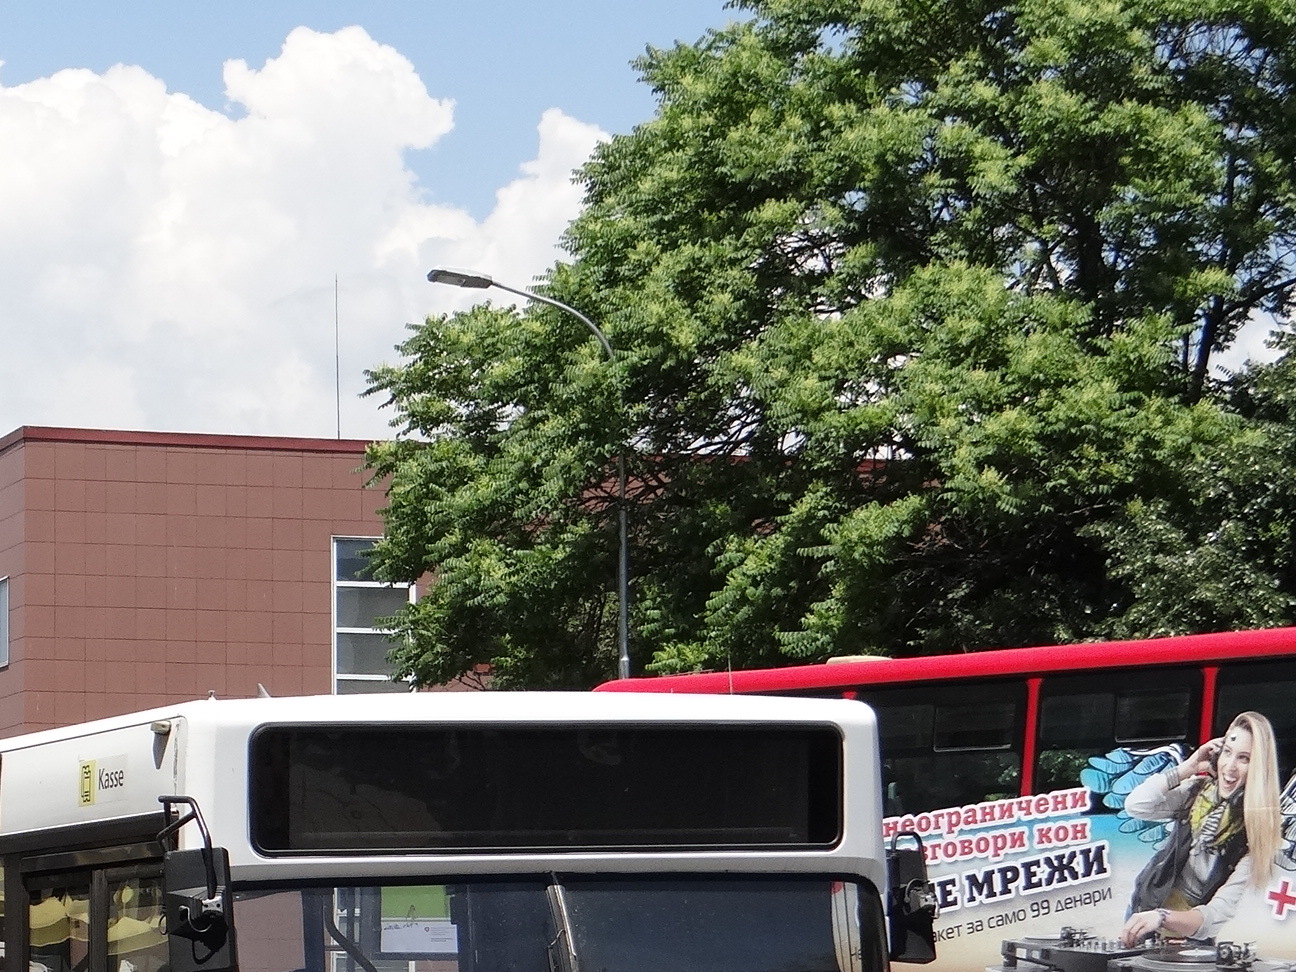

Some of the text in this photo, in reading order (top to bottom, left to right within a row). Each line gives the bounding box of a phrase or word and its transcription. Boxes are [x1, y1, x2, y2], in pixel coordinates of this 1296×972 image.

[98, 768, 124, 790] Kasse
[883, 790, 1088, 837] неограничени
[922, 822, 1088, 862] зговори кон
[965, 844, 1107, 903] МРЕЖИ
[933, 886, 1113, 944] акет за само 99 денари
